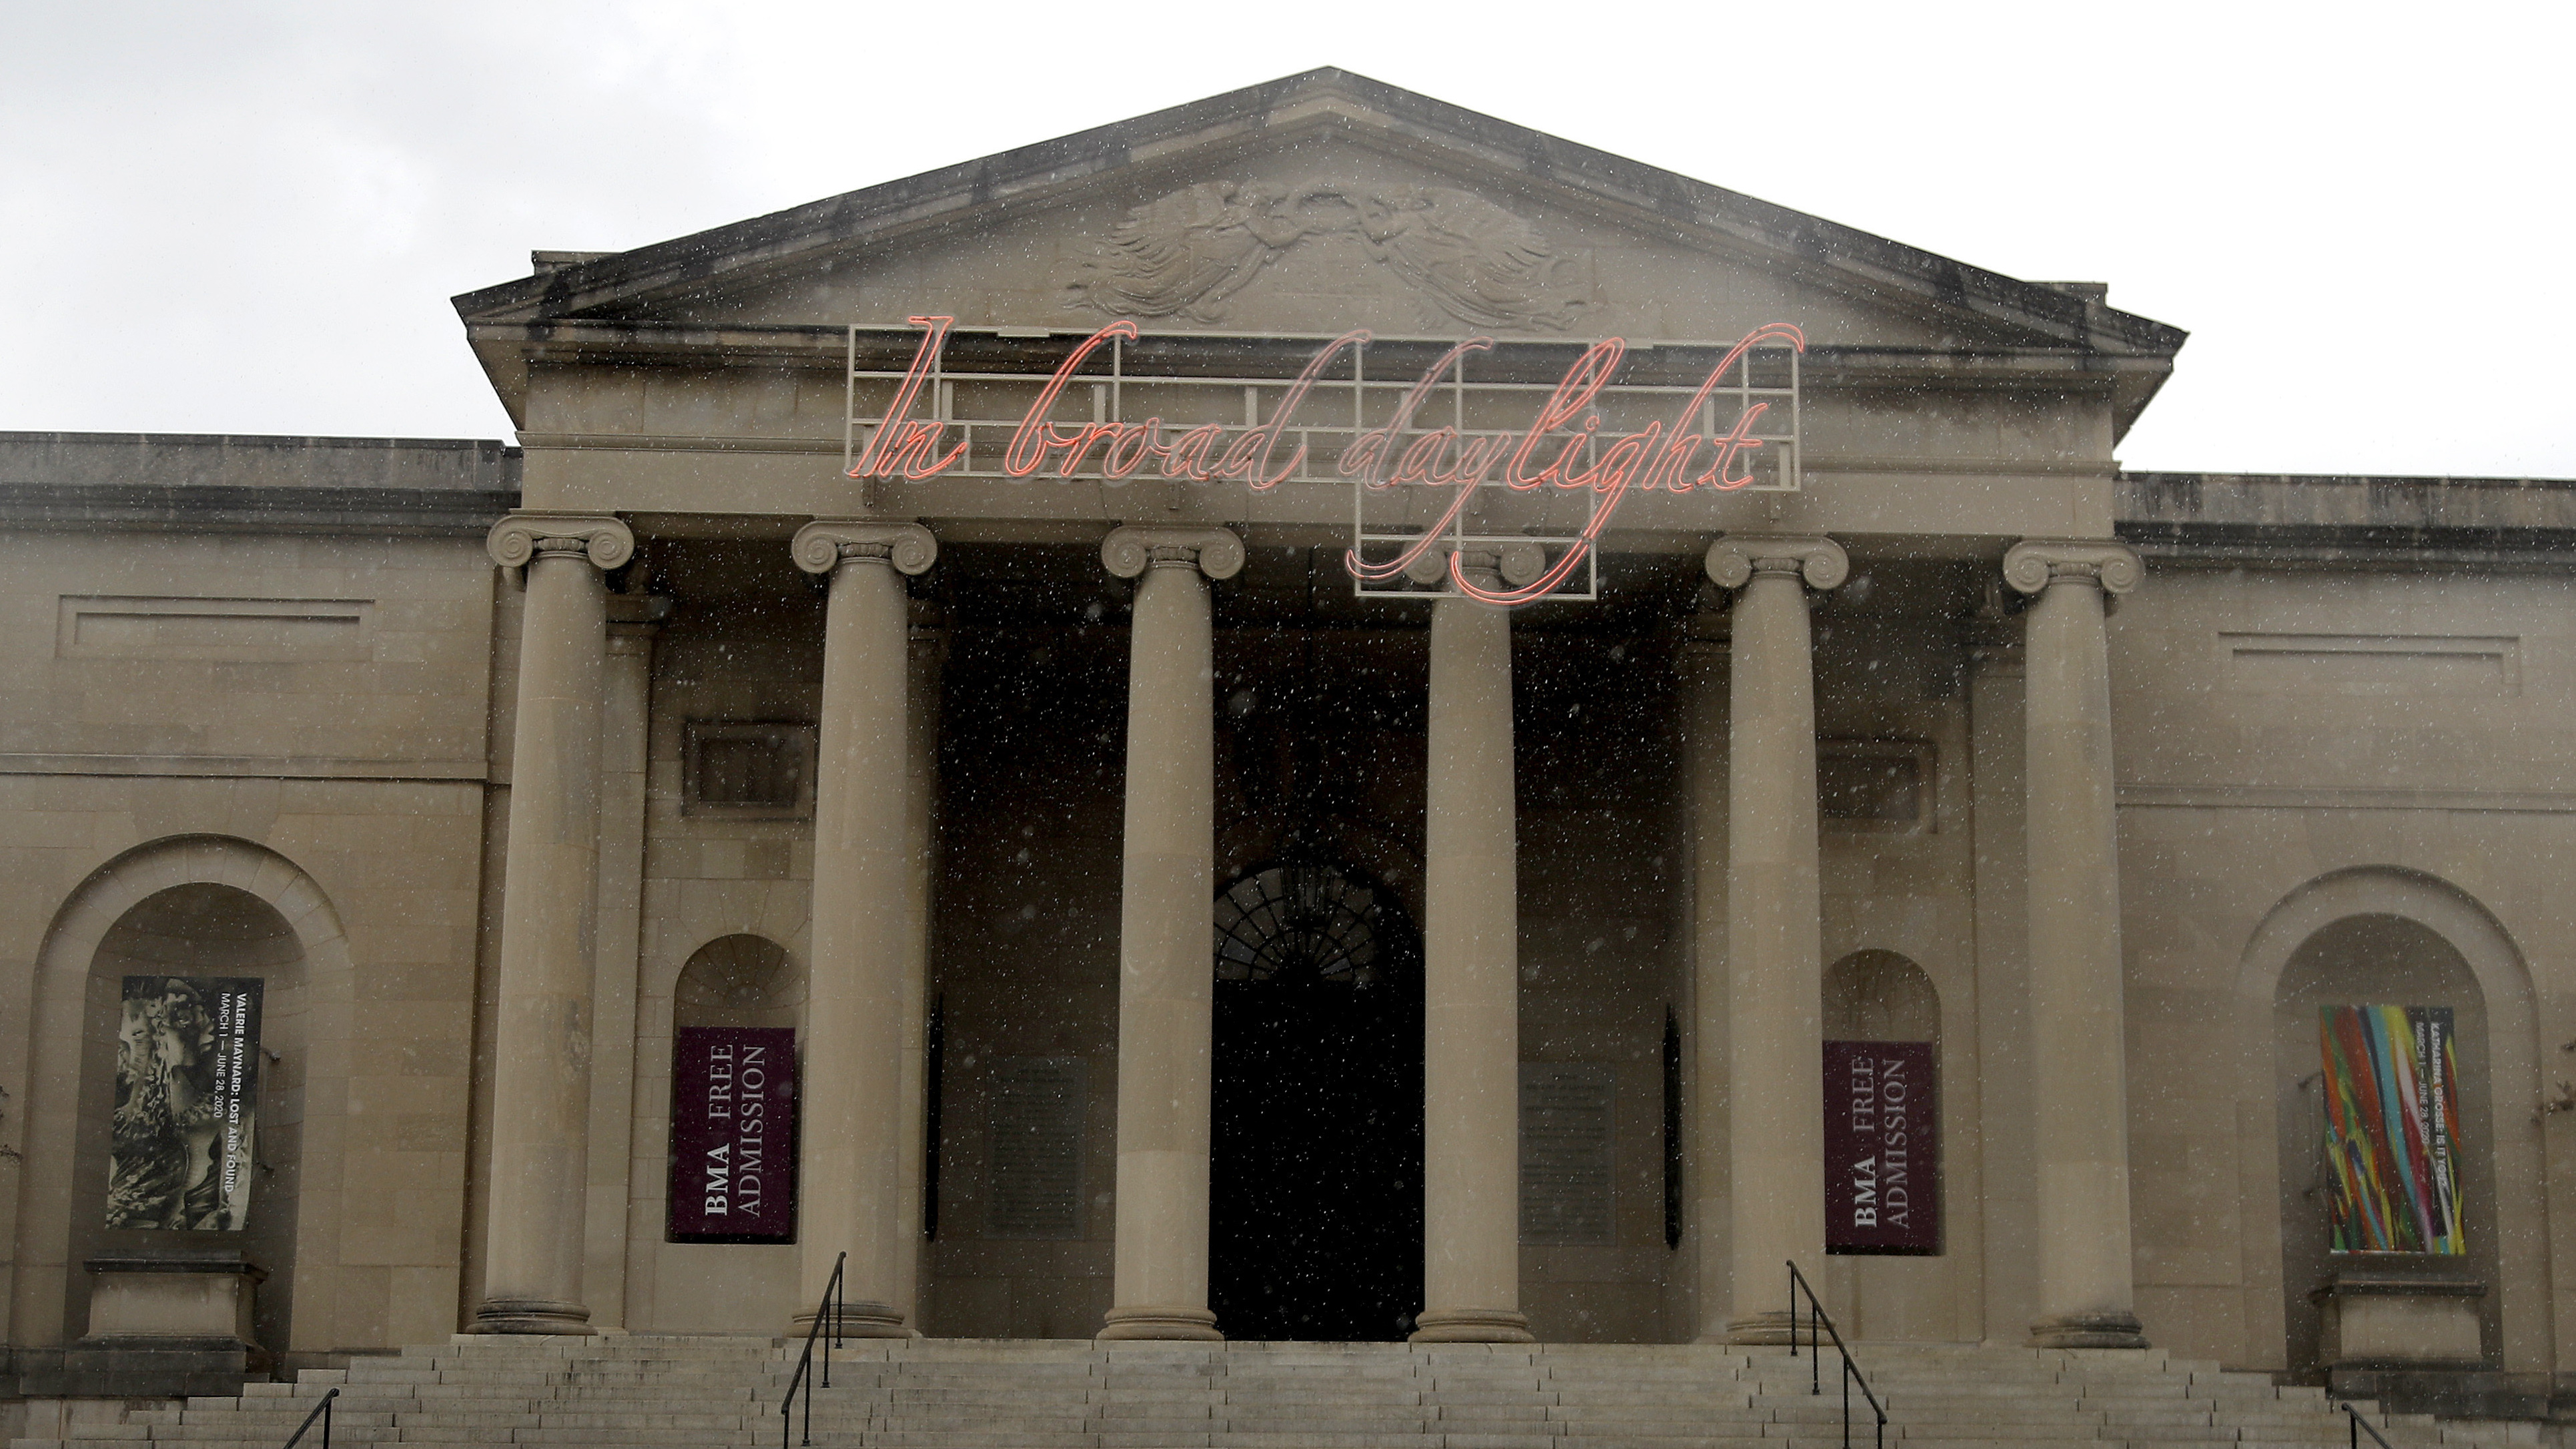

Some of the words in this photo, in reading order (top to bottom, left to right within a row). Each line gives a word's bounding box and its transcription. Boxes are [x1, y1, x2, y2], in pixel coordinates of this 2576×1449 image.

[846, 316, 968, 480] In
[1005, 320, 1372, 490] broad
[1338, 323, 1803, 606] daylight
[219, 993, 231, 1029] MARCH
[235, 993, 247, 1035] VALERIE
[2417, 1022, 2426, 1059] MARCH
[2431, 1023, 2442, 1084] KATHARINA
[216, 1053, 227, 1077] JUNE
[231, 1037, 244, 1095] MAYNARD:
[709, 1044, 733, 1119] FREE
[214, 1079, 226, 1093] 28,
[1852, 1058, 1875, 1132] FREE
[2419, 1081, 2429, 1104] JUNE
[213, 1095, 224, 1117] 2020
[229, 1099, 240, 1124] LOST
[2434, 1087, 2445, 1131] GROSSE:
[228, 1127, 238, 1151] AND
[738, 1044, 766, 1218] ADMISSION
[1883, 1059, 1909, 1229] ADMISSION
[2421, 1121, 2430, 1144] 2020
[2437, 1135, 2446, 1145] IS
[2437, 1147, 2446, 1156] IT
[224, 1155, 236, 1192] FOUND
[705, 1143, 730, 1216] BMA
[1854, 1155, 1877, 1228] BMA
